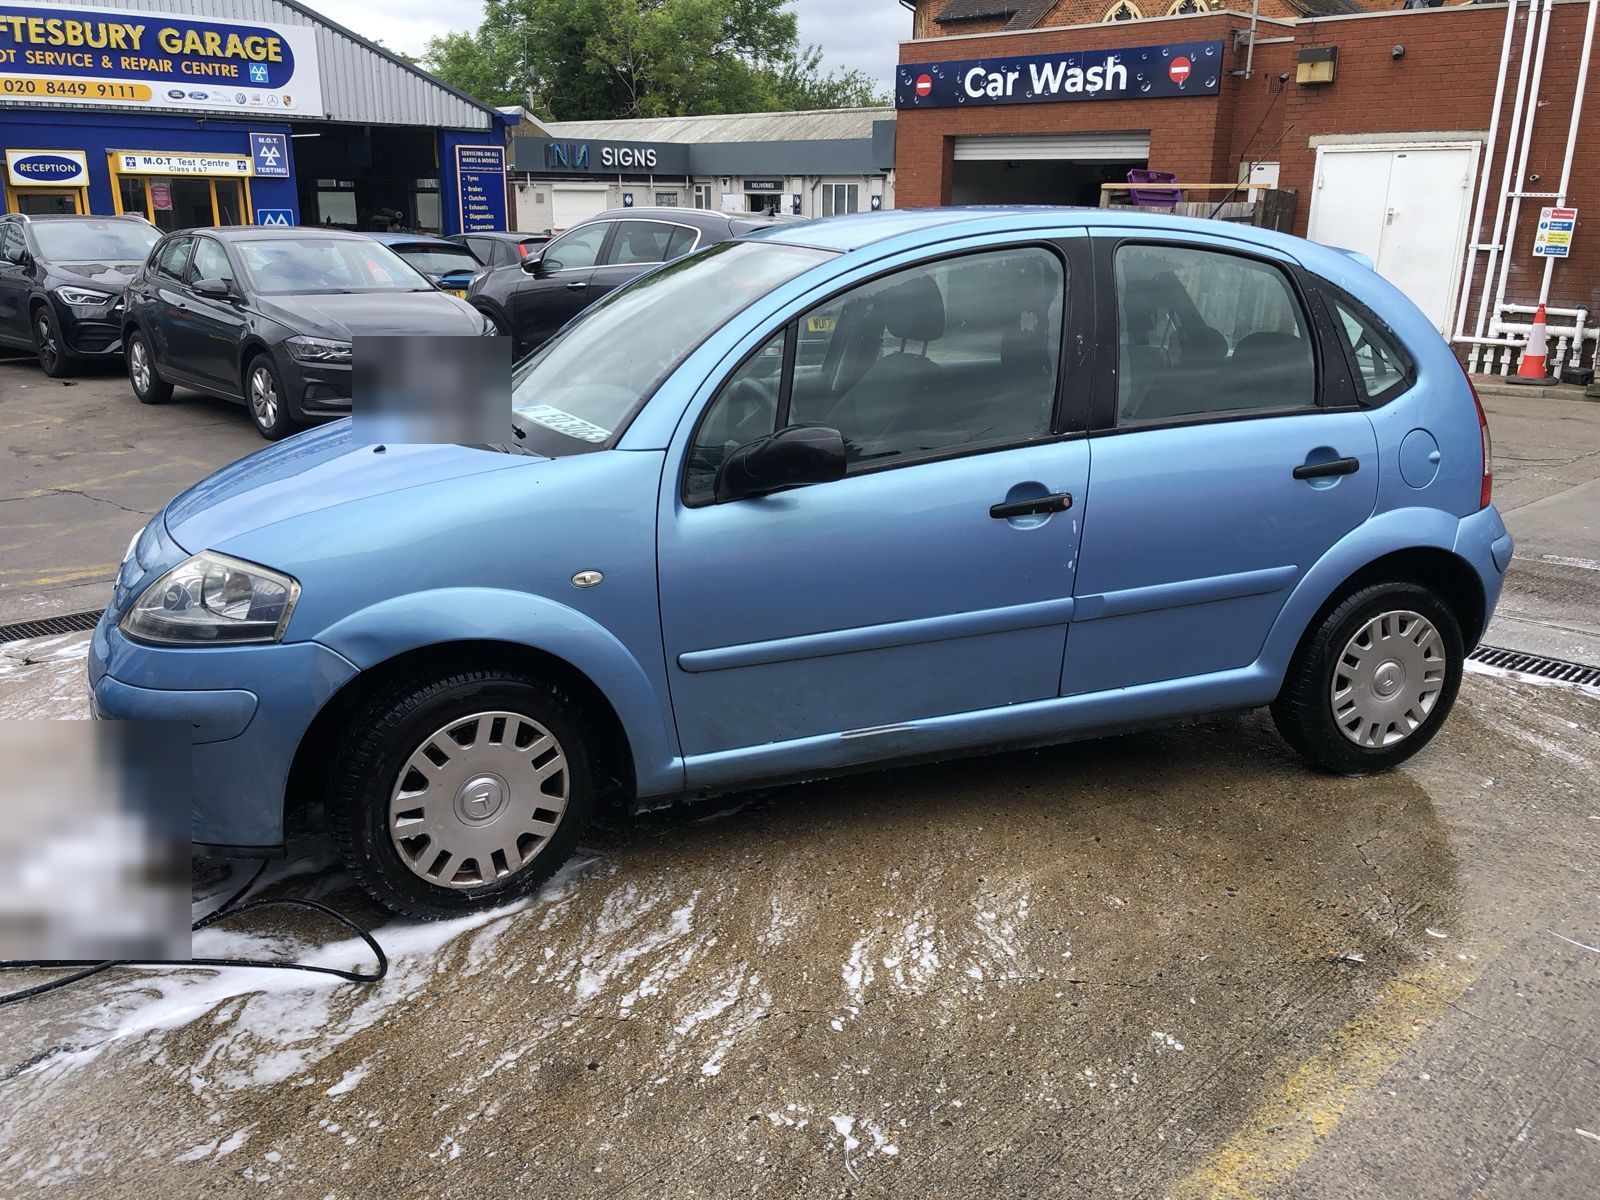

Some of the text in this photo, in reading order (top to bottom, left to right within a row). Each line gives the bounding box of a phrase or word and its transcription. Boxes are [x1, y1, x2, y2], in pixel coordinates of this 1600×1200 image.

[158, 27, 283, 62] GARAGE
[25, 50, 94, 68] SERVICE
[101, 55, 113, 69] &
[120, 56, 174, 73] REPAIR
[181, 61, 239, 78] CENTRE
[964, 56, 1128, 98] Car Wash
[4, 79, 135, 98] 020 8449 9111
[177, 158, 196, 166] Test
[200, 159, 230, 168] Centre
[602, 147, 657, 167] SIGNS
[20, 163, 76, 172] RECEPTION
